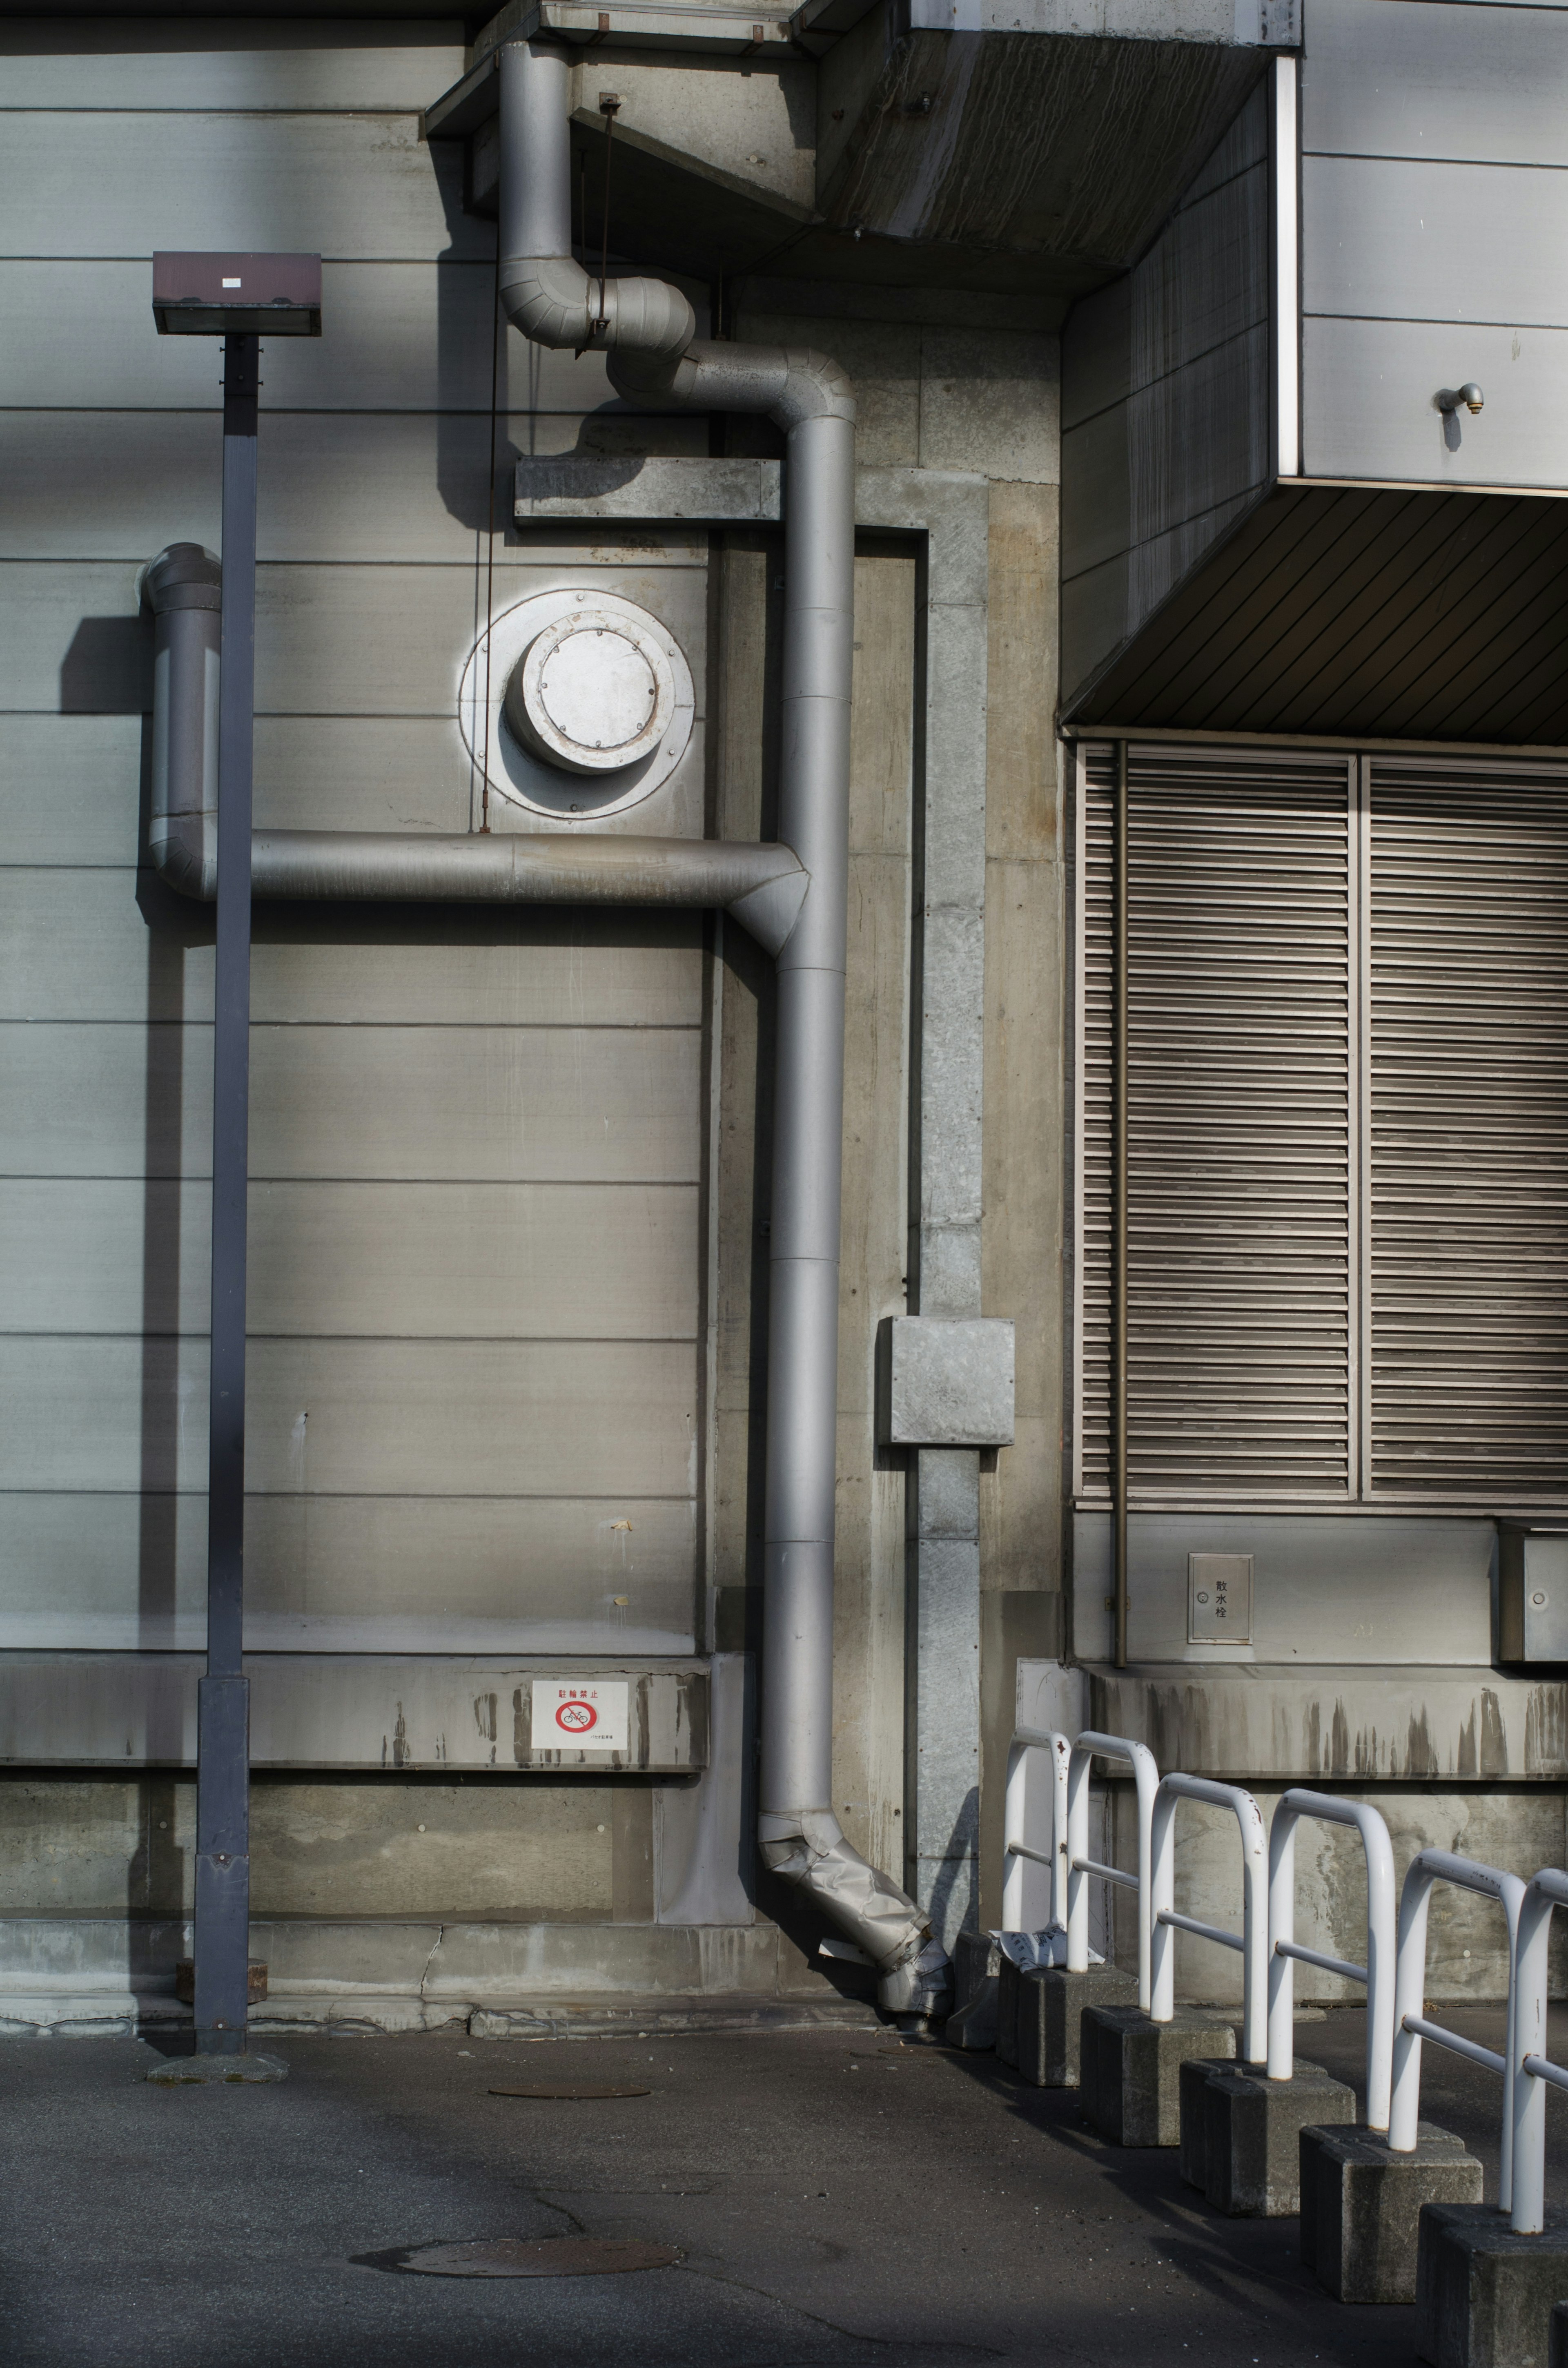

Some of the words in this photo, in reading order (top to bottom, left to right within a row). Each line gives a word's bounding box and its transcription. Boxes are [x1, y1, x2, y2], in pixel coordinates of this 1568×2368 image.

[1215, 1581, 1227, 1617] 散水栓
[559, 1690, 598, 1698] 駐輪禁止
